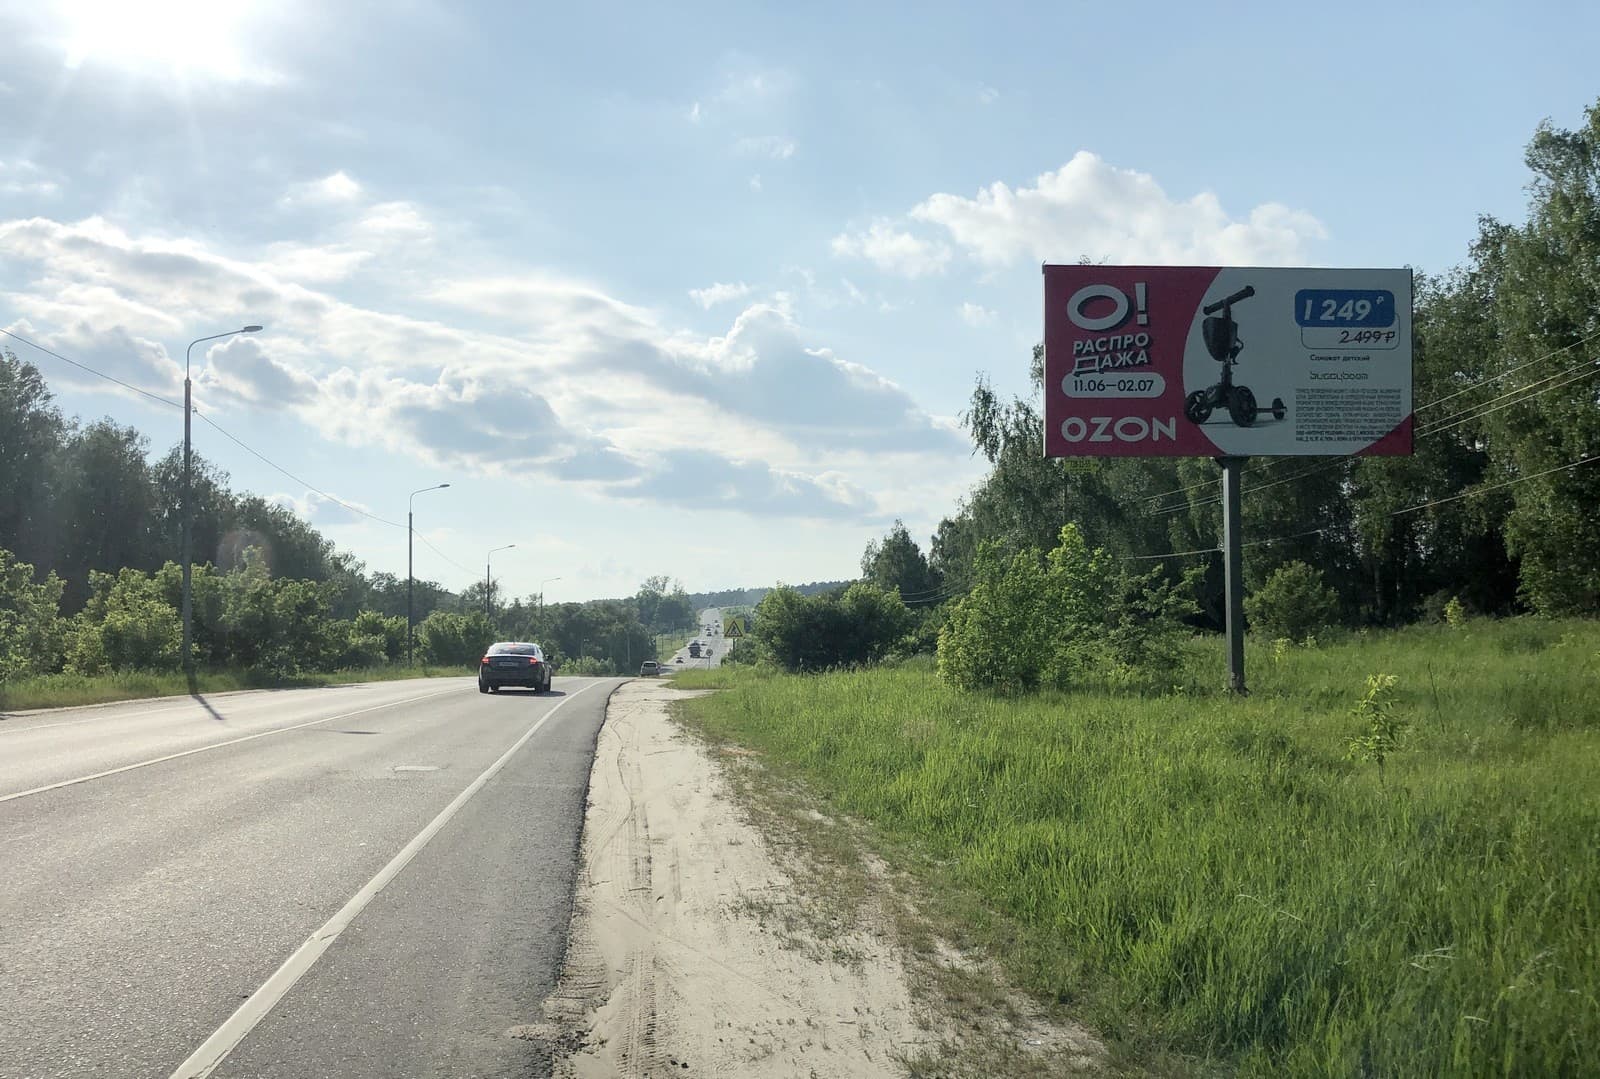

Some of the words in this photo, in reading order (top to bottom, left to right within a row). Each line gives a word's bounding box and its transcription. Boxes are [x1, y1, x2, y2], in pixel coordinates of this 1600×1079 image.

[1072, 332, 1149, 355] РАСПРО
[1072, 351, 1148, 375] ДАЖА
[1061, 416, 1177, 442] OZON
